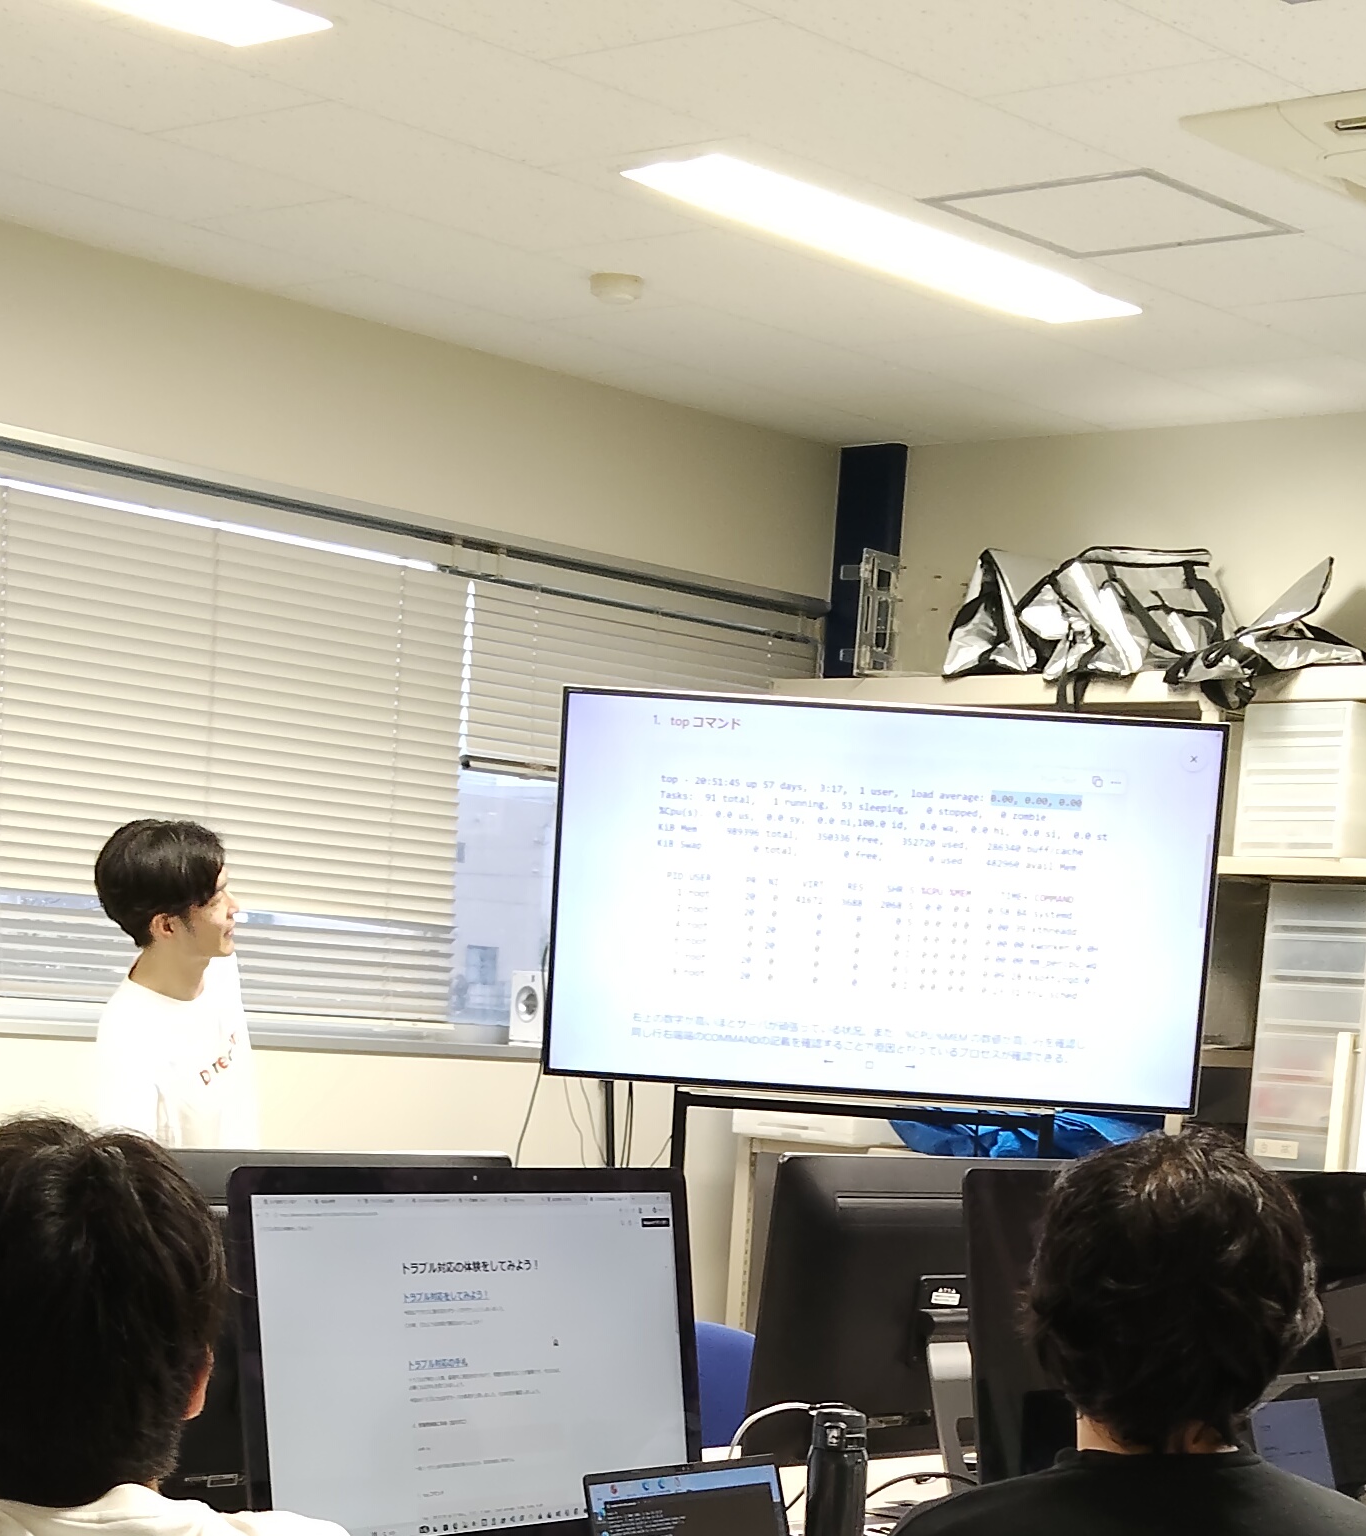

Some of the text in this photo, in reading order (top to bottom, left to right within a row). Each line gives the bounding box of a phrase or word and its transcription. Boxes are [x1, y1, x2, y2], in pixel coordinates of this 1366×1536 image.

[670, 715, 690, 729] top
[692, 715, 741, 730] コマンド
[661, 774, 678, 785] top
[780, 781, 809, 793] days,
[820, 783, 849, 795] 3:17,
[871, 788, 900, 798] user,
[911, 788, 934, 798] load
[939, 790, 985, 803] average:
[991, 793, 1020, 805] 0.00,
[1025, 795, 1054, 807] 0.00,
[1059, 797, 1082, 807] 0.00
[402, 1259, 540, 1275] トラブル対応の体験をしてみよう！
